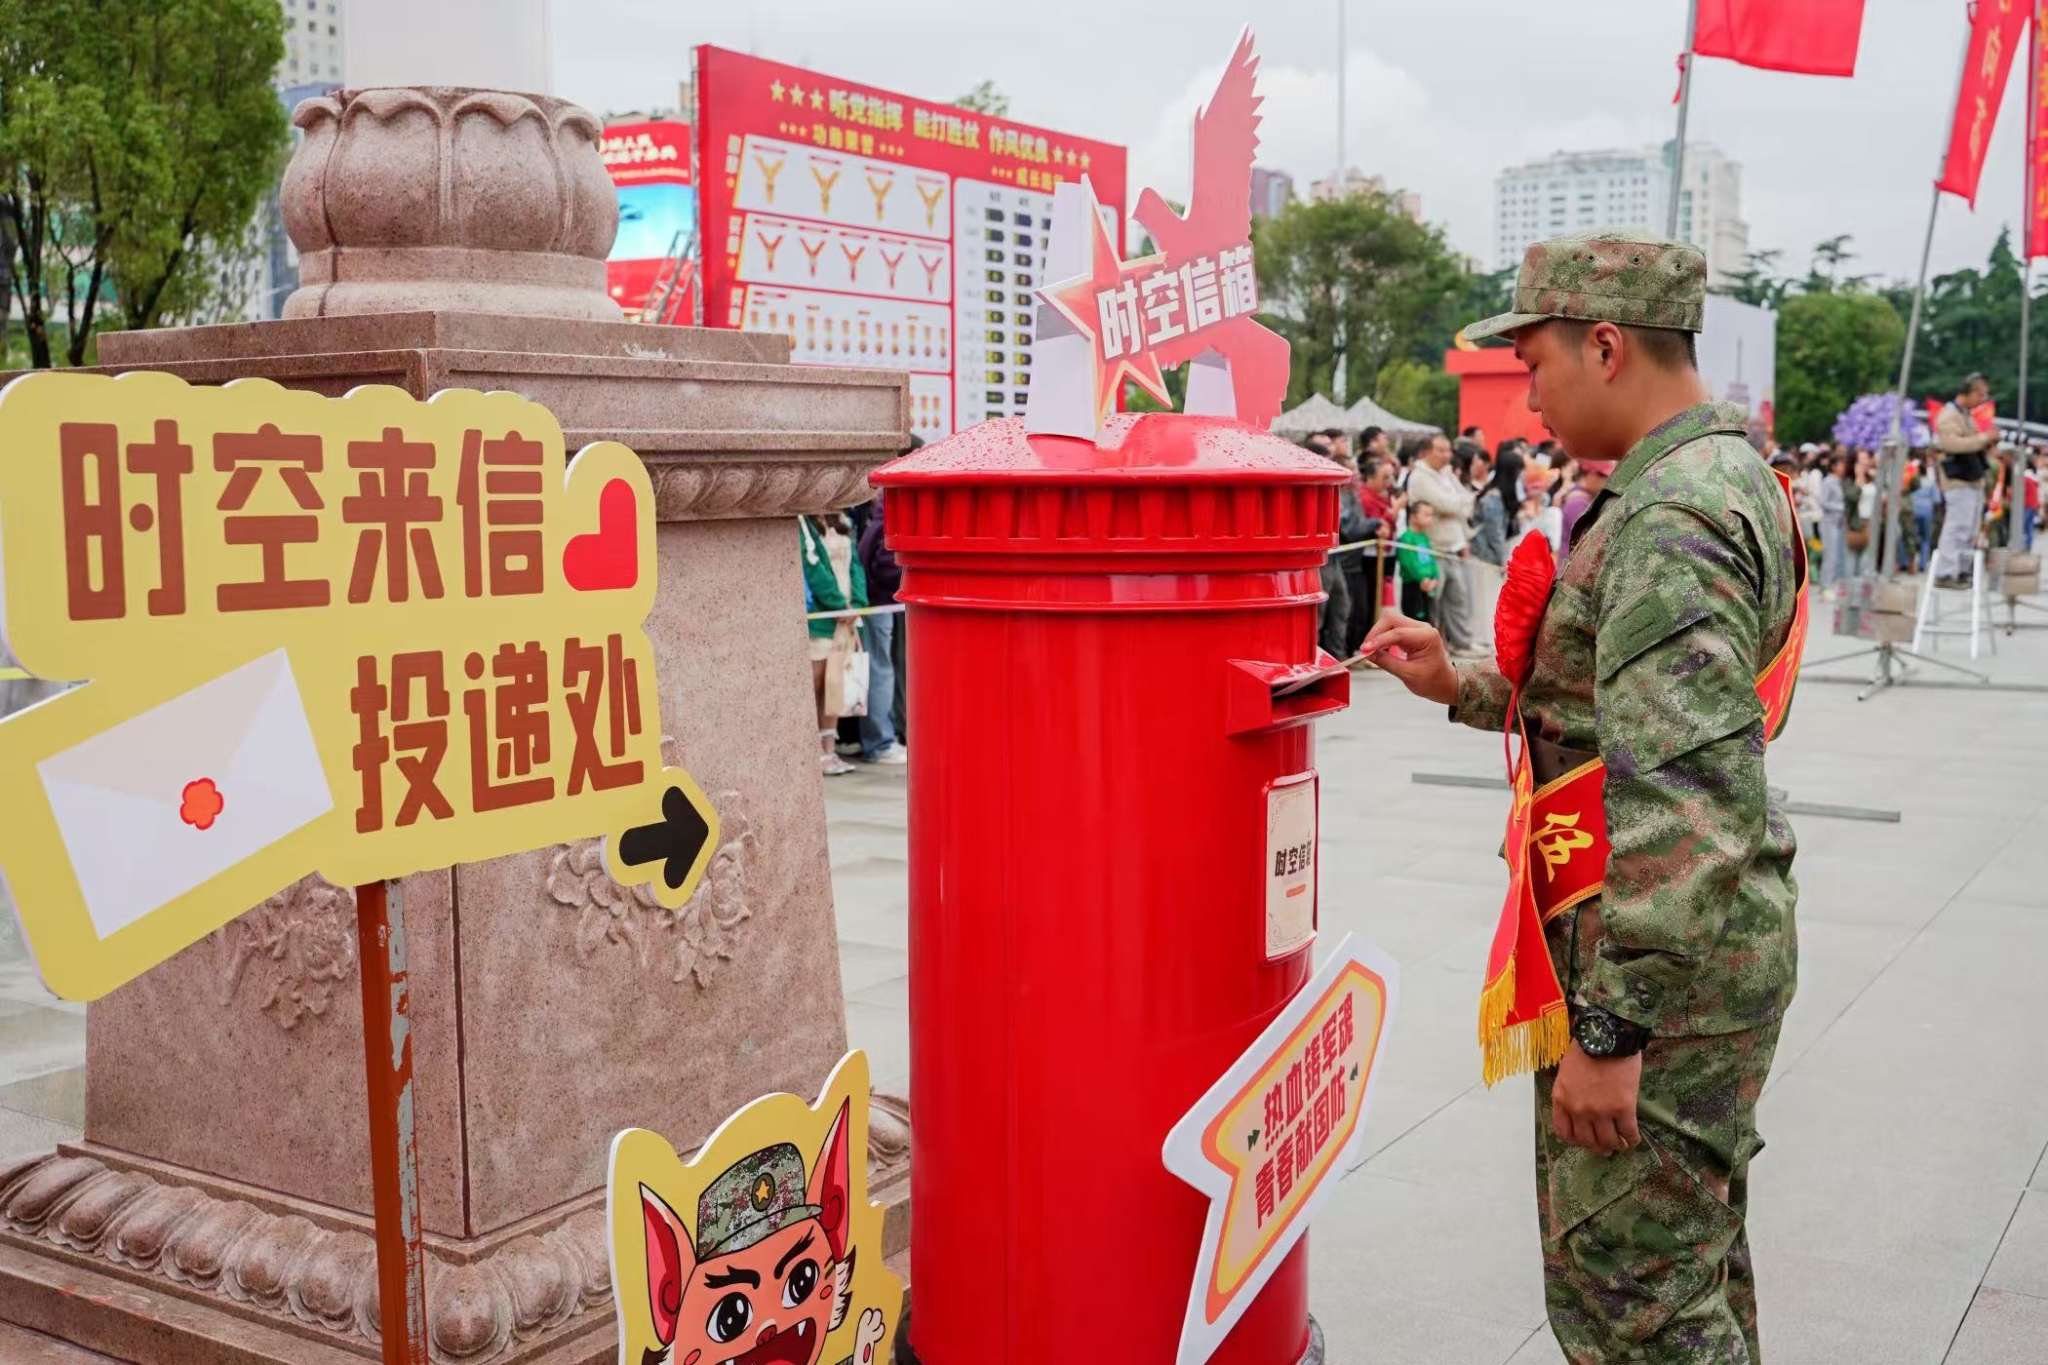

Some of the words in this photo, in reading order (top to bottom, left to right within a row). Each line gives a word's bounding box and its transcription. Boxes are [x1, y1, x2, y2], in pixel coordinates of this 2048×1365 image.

[1097, 246, 1257, 359] 时空信箱
[60, 419, 544, 621] 时空来信
[350, 634, 644, 834] 投递处
[1256, 1064, 1346, 1230] 青春献国防
[1264, 991, 1353, 1152] 热血铸军魂
